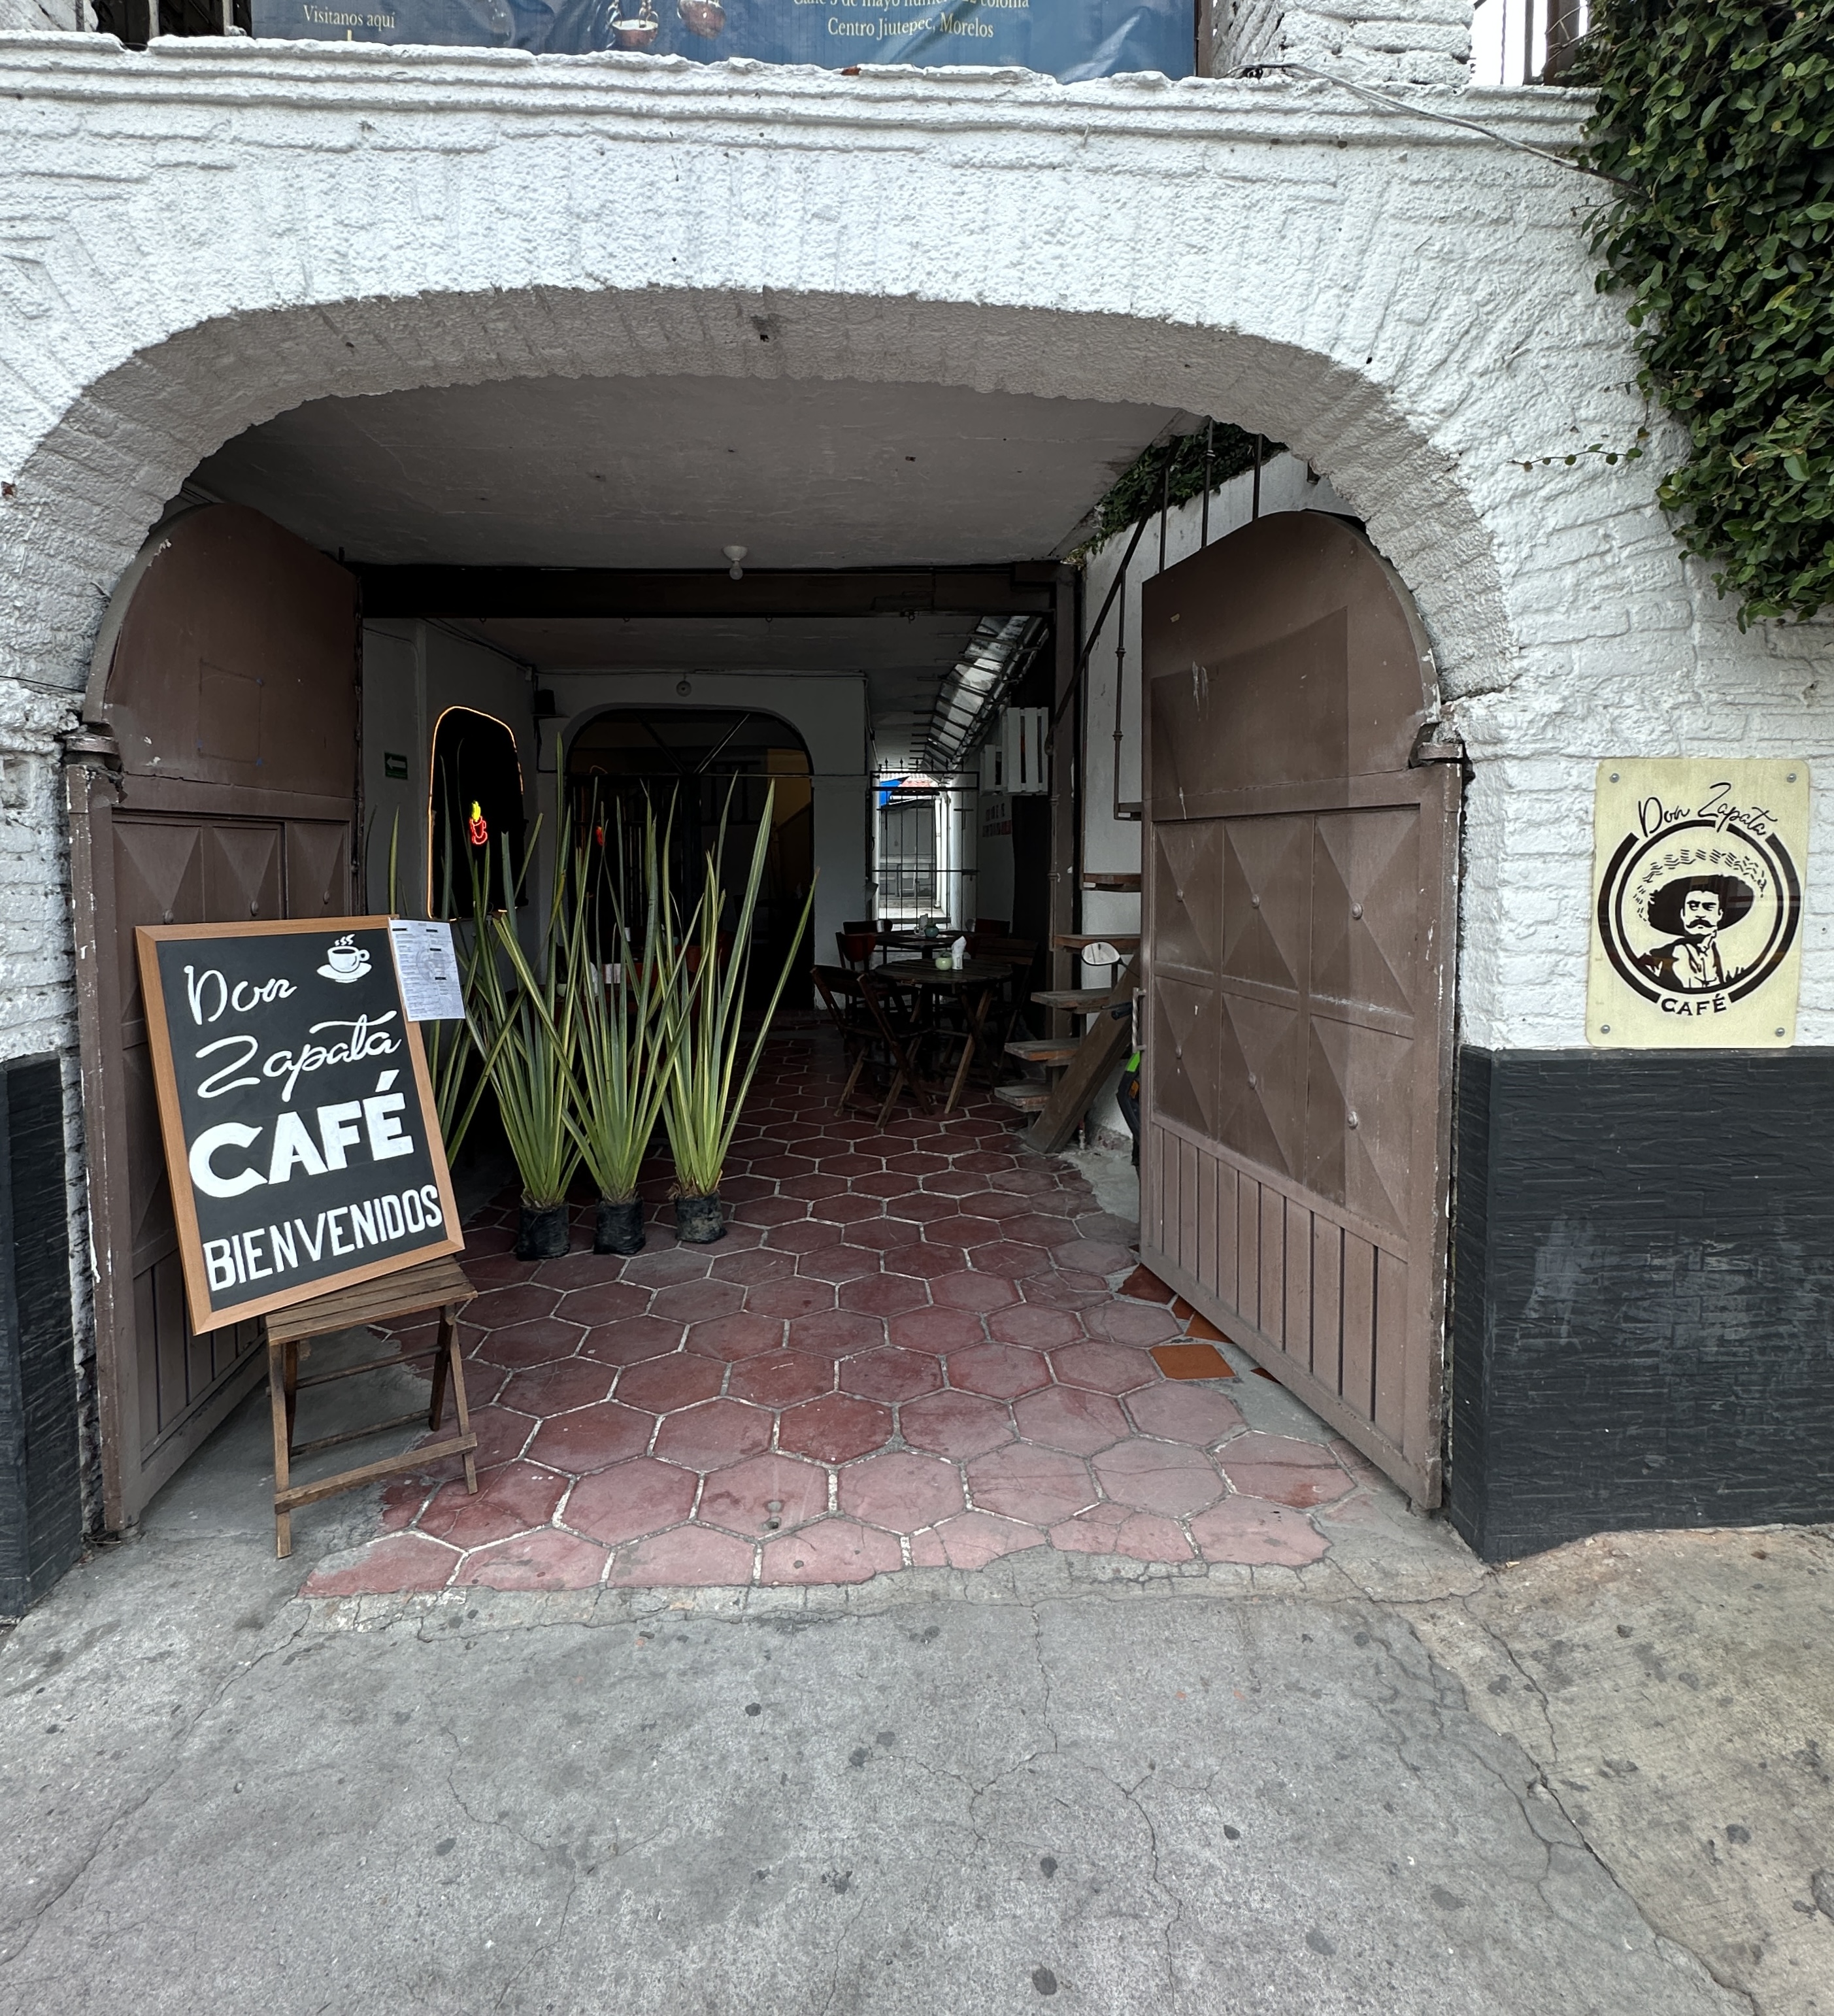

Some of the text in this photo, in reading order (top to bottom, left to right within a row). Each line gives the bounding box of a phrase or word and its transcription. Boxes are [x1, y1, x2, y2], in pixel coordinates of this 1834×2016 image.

[367, 12, 395, 31] aquí
[827, 12, 993, 41] Centro Jiutepec, Morelos
[1638, 782, 1778, 837] Don Zapata
[184, 965, 297, 1025] Don
[1661, 993, 1727, 1016] CAFÉ
[195, 1011, 401, 1102] Zapata
[189, 1069, 414, 1199] CAFÉ
[202, 1184, 443, 1292] BIENVENIDOS
